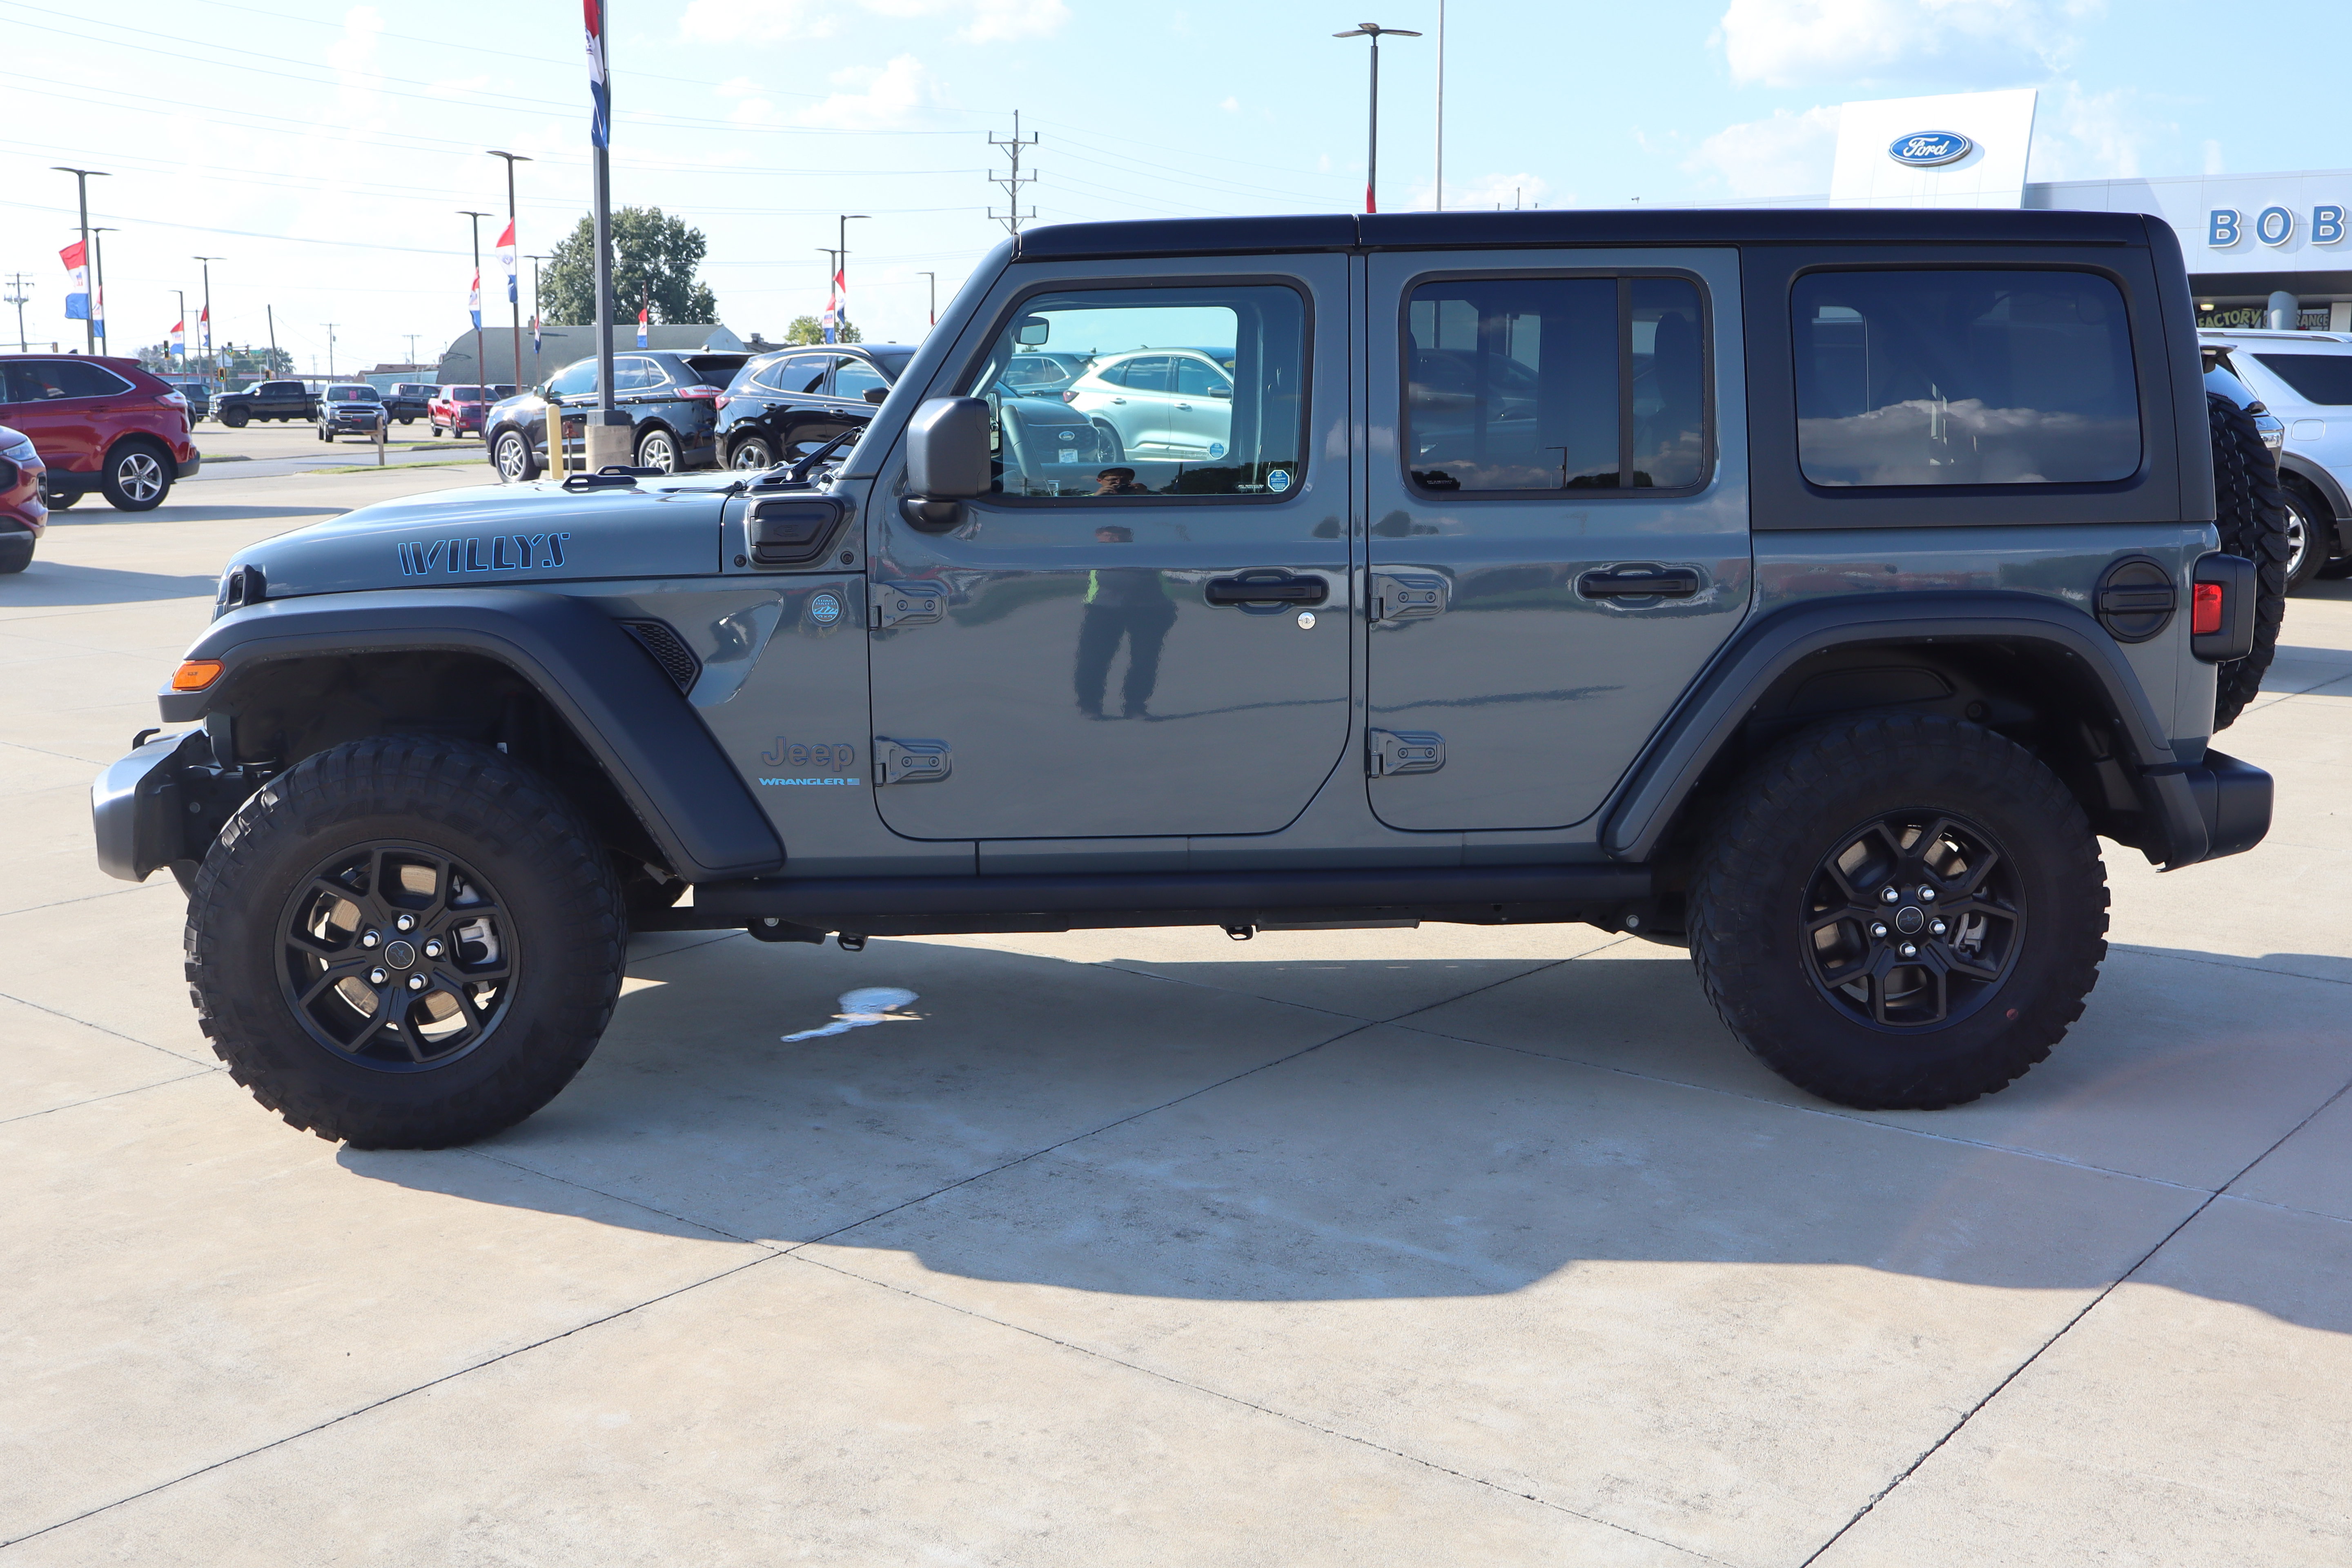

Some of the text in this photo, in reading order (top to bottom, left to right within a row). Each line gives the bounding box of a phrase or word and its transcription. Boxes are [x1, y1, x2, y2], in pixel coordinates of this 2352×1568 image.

[1903, 137, 1950, 157] Ford
[2208, 205, 2345, 247] BOB
[2197, 310, 2262, 327] FACTORY
[398, 532, 570, 575] WILLYS
[762, 736, 855, 772] Jeep
[759, 777, 845, 786] WRANGLER
